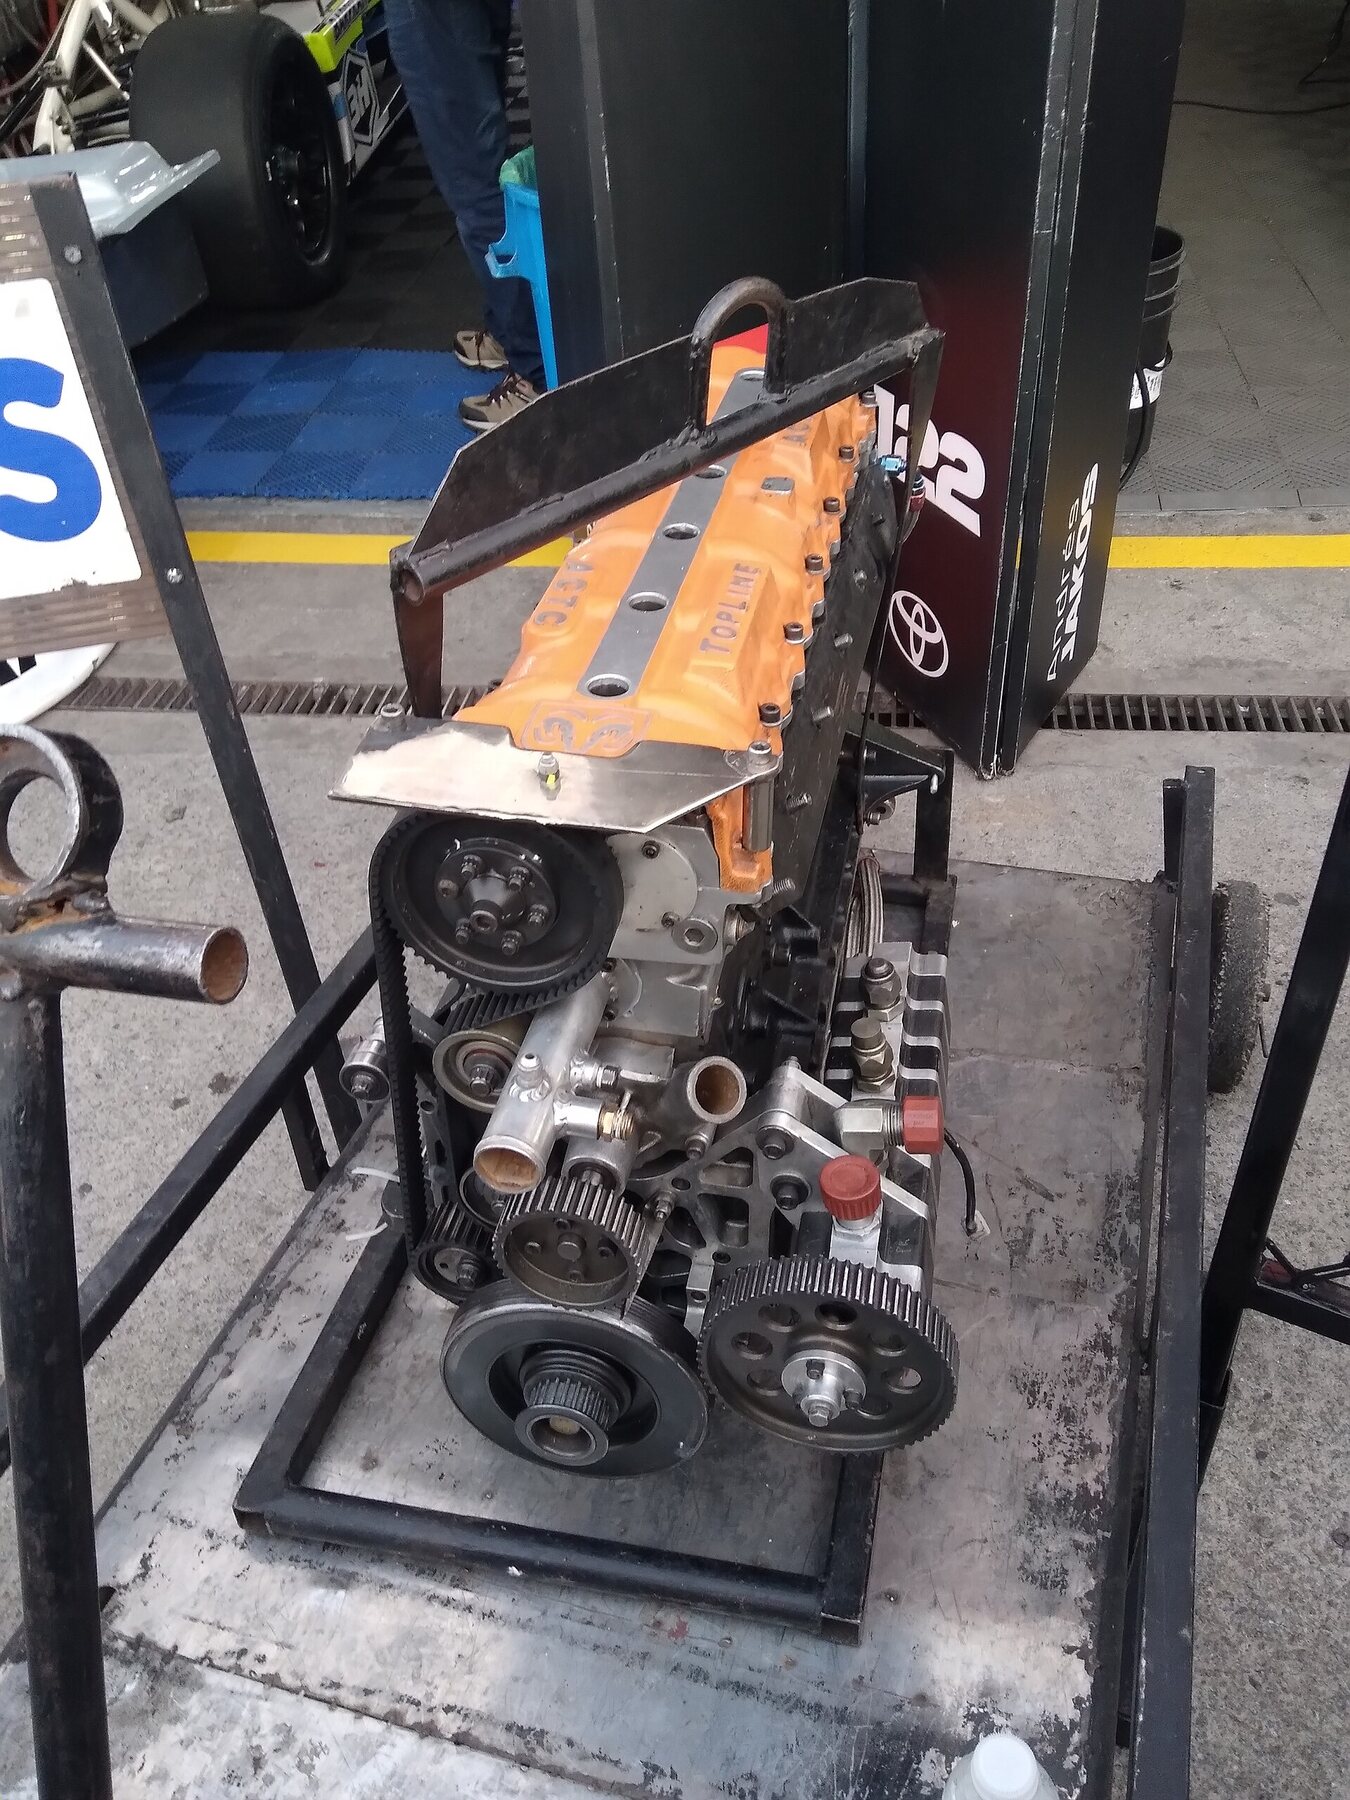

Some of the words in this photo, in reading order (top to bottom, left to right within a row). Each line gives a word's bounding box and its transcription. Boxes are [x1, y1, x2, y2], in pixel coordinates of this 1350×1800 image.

[0, 357, 102, 542] S
[699, 562, 762, 655] TOPLINE
[1047, 497, 1080, 682] Andrés
[1061, 462, 1099, 662] JAKOS
